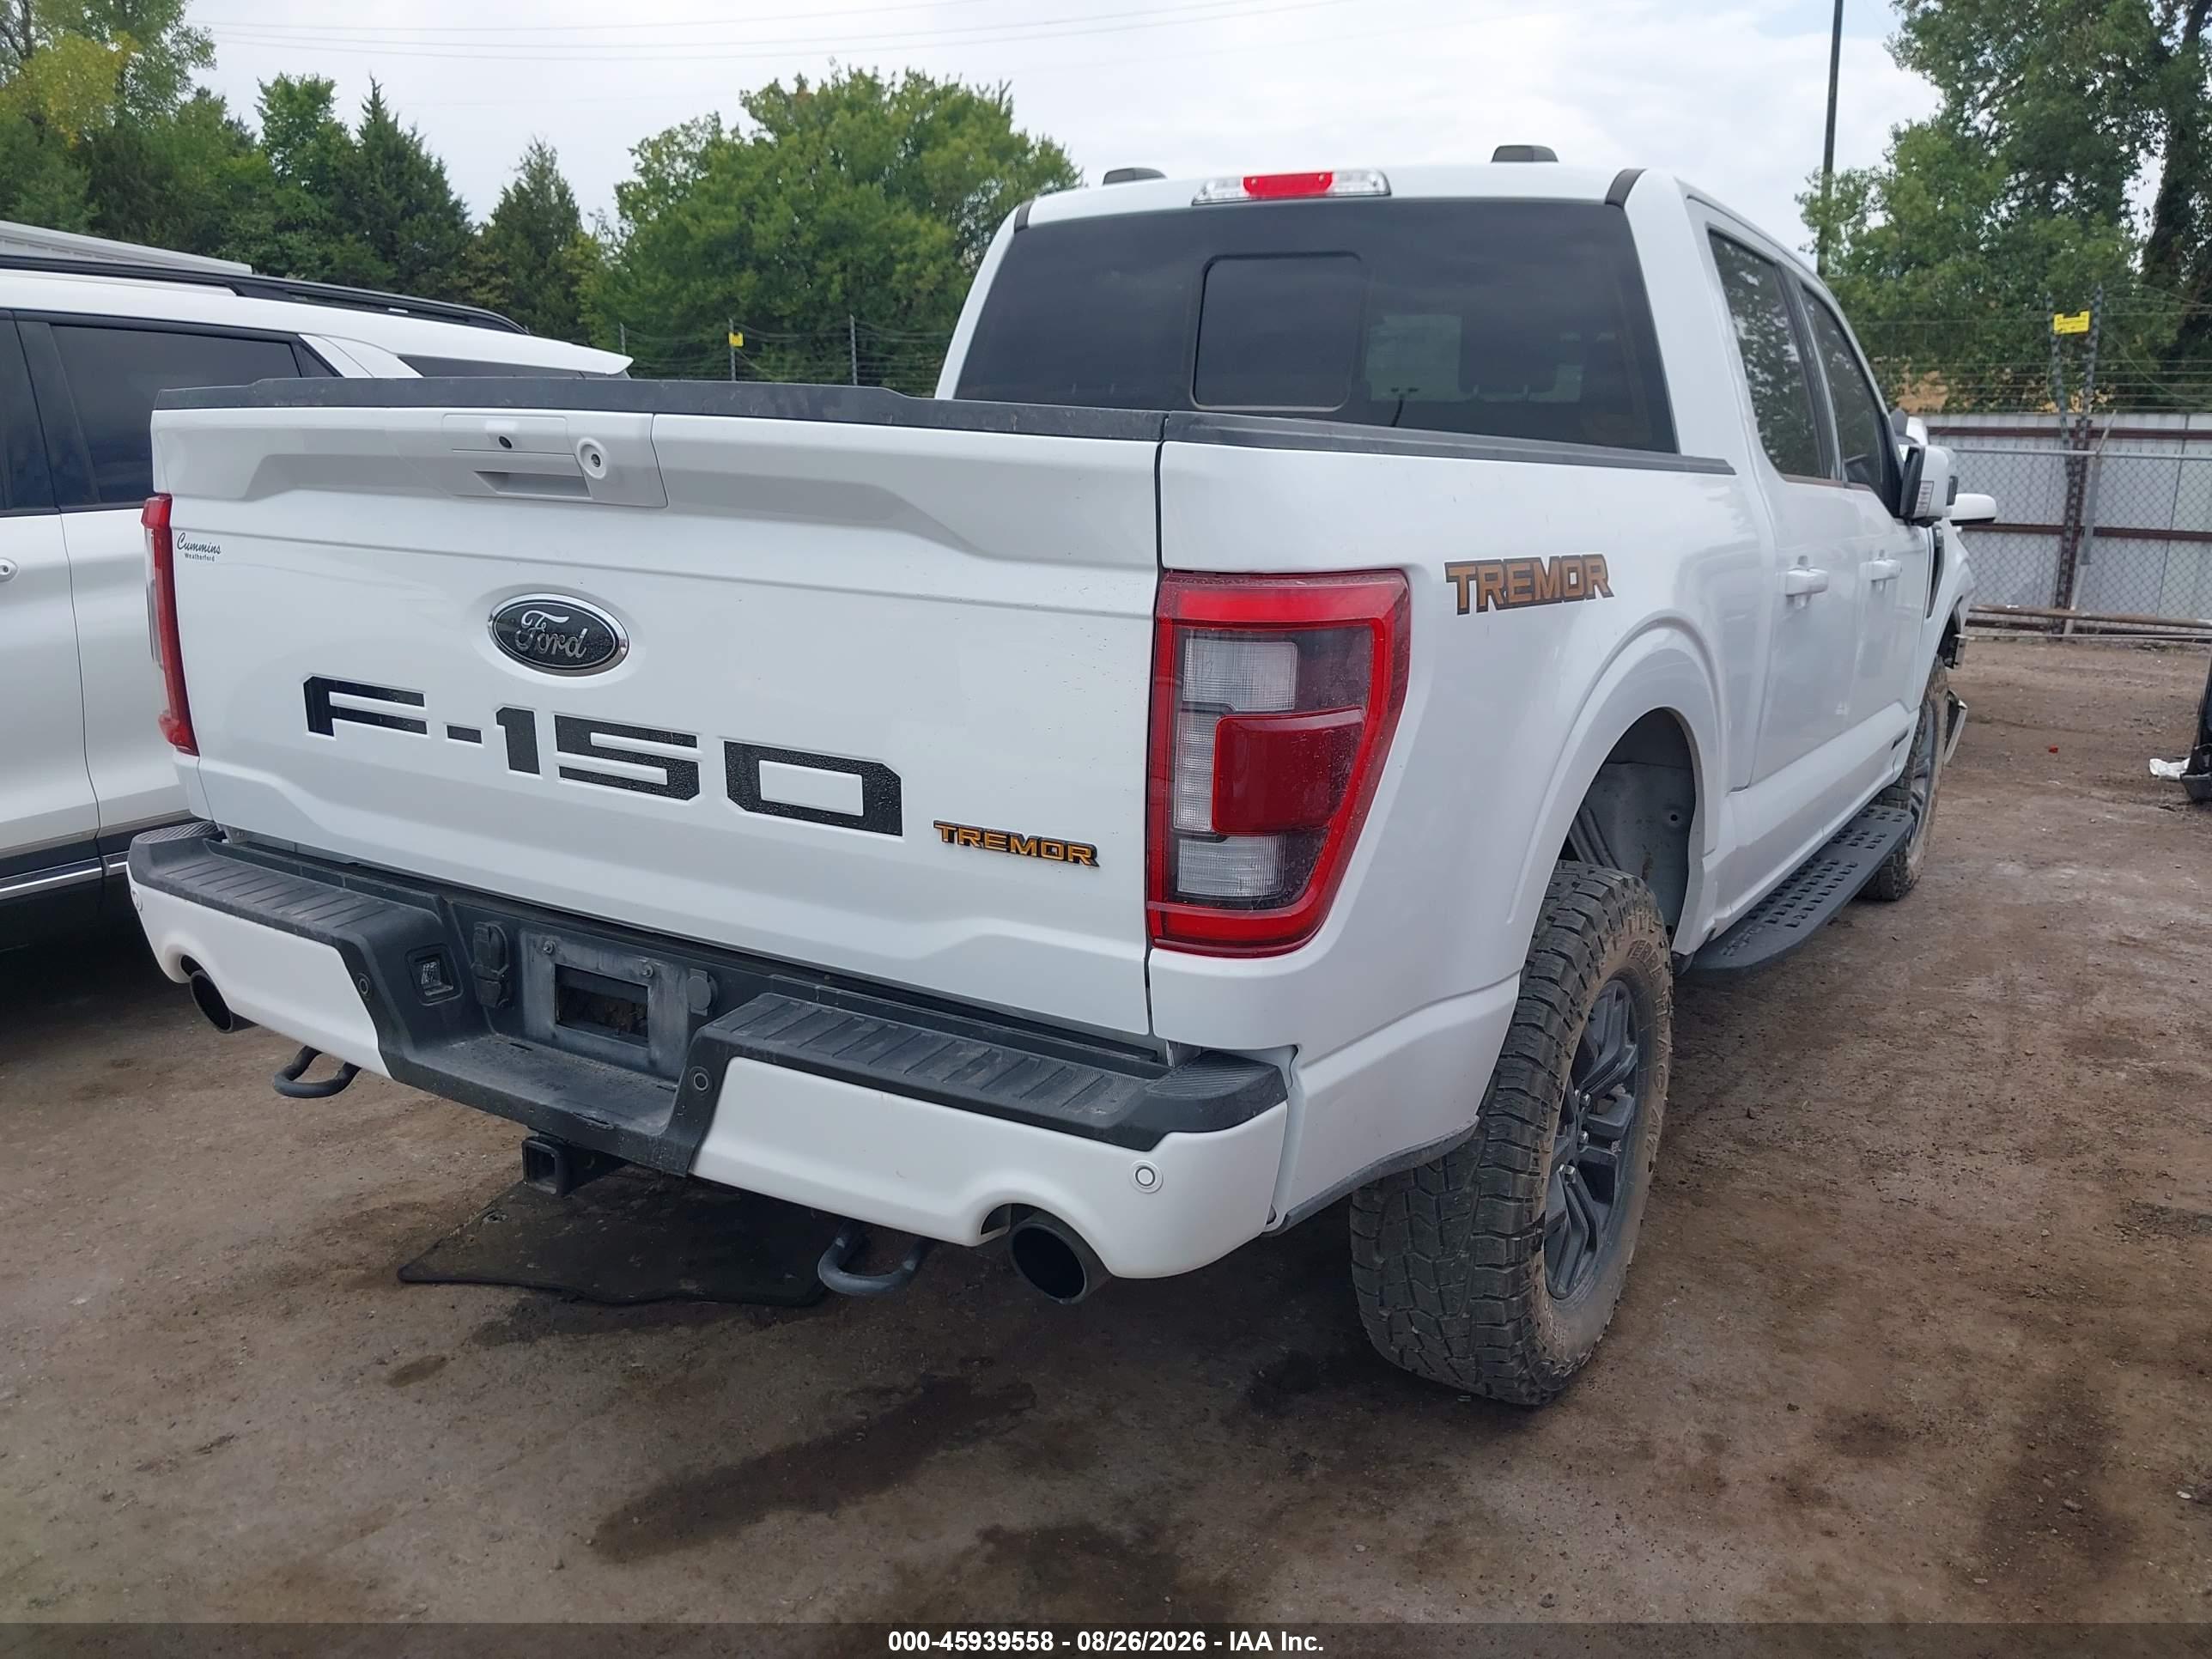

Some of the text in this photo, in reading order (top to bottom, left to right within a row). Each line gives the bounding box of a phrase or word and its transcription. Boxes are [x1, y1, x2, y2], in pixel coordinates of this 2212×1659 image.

[176, 532, 222, 555] Cummins
[184, 553, 216, 562] Weatherford
[1444, 554, 1614, 616] TREMOR
[515, 610, 588, 659] Ford
[303, 676, 903, 837] F-150
[933, 820, 1100, 867] TREMOR
